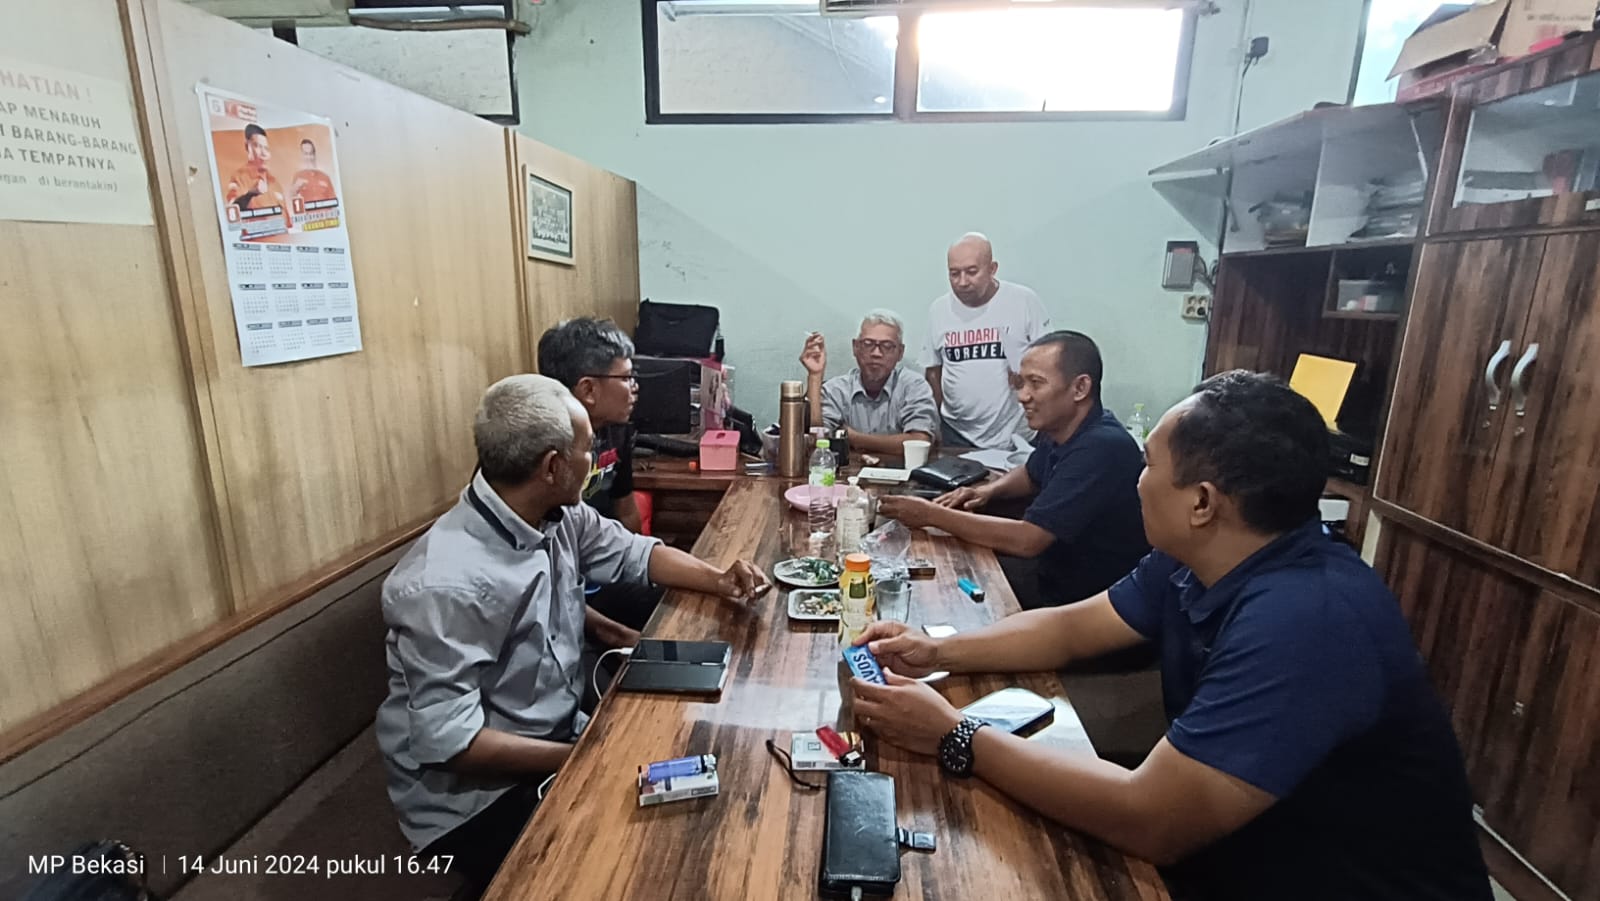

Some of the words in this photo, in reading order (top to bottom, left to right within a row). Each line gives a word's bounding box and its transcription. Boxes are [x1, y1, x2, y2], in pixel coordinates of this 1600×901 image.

[23, 104, 101, 129] MENARUH
[11, 125, 137, 155] BARANG-BARANG
[18, 148, 116, 171] TEMPATNYA
